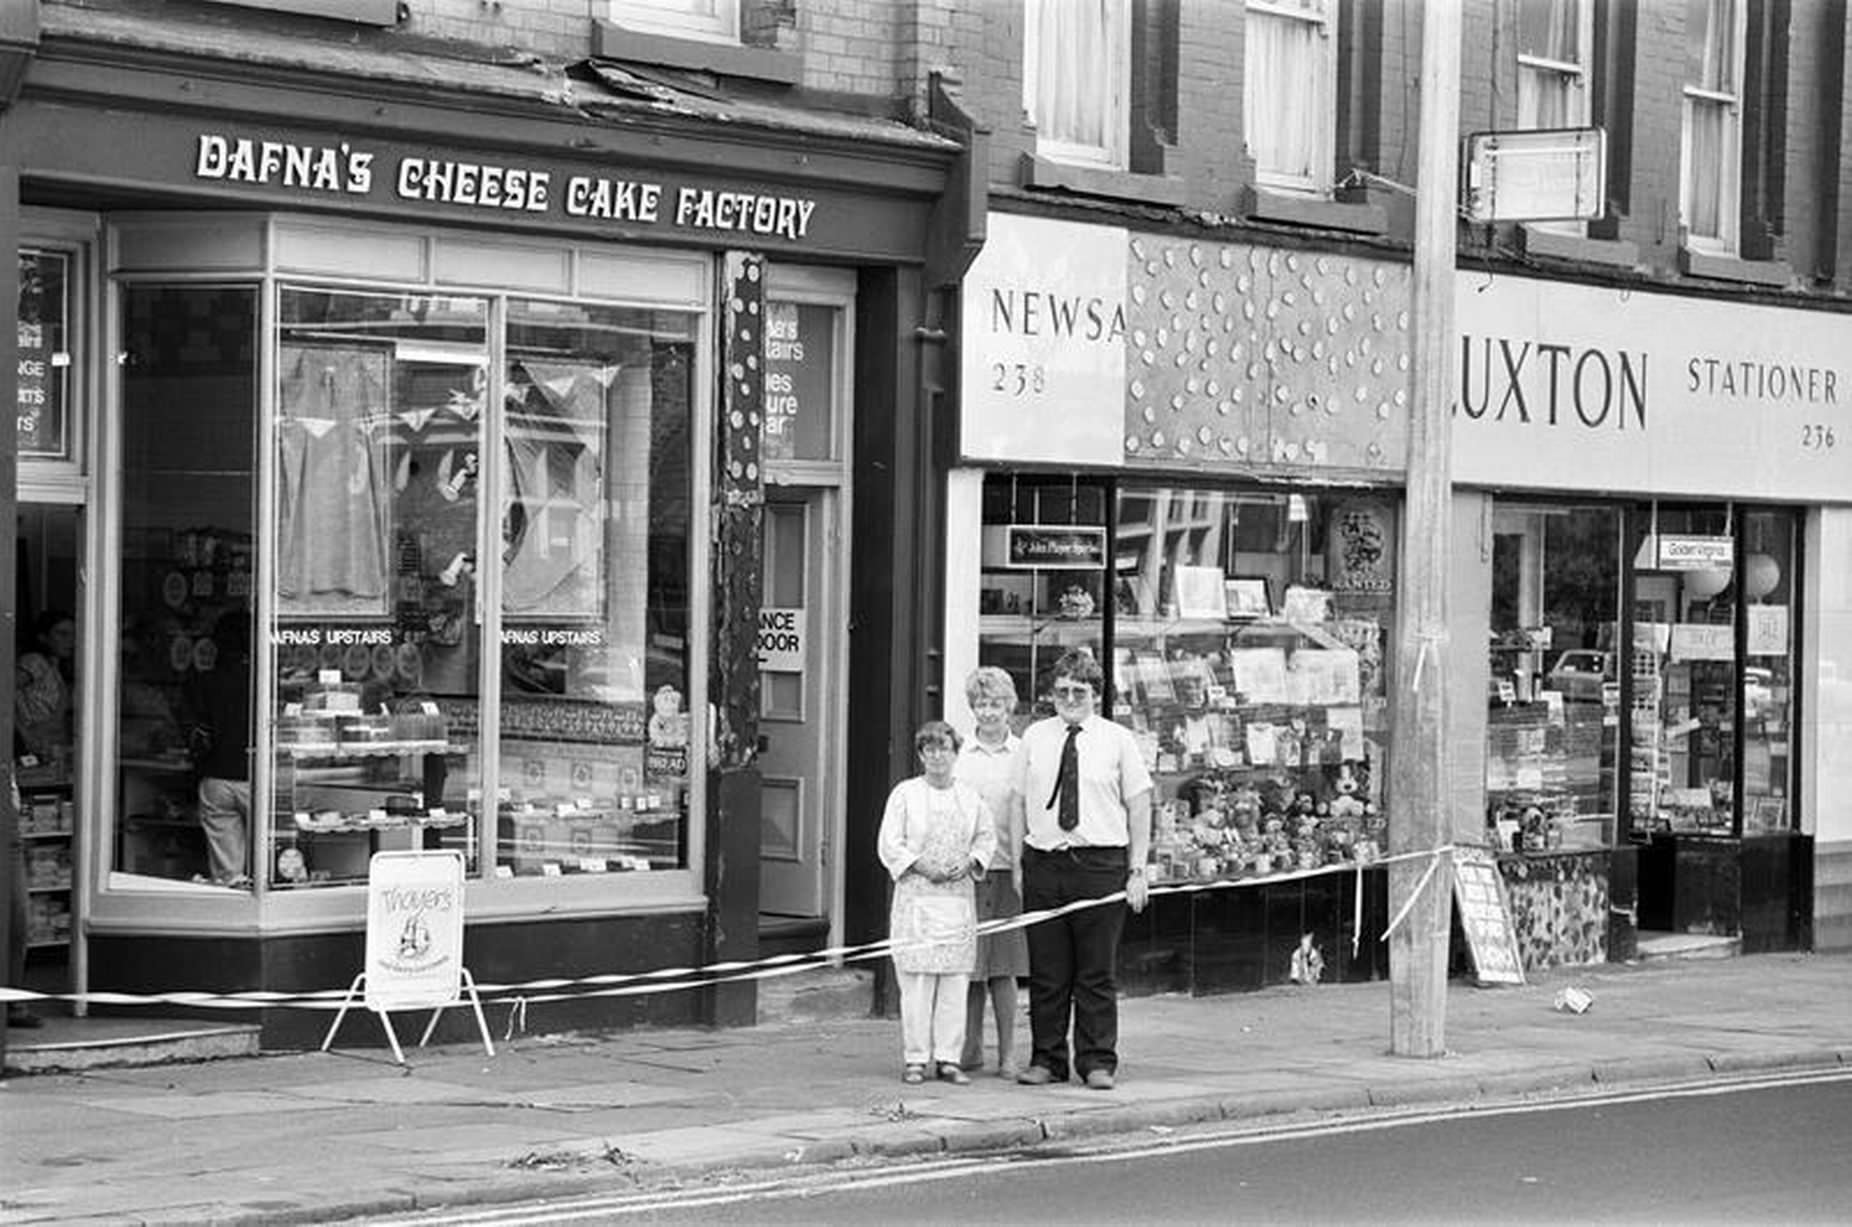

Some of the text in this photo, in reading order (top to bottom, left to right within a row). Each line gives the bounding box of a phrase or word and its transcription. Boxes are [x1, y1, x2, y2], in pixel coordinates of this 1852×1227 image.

[197, 134, 816, 239] DAFNA'S CHEESE CAKE FACTORY
[992, 362, 1045, 396] 238
[1452, 335, 1837, 431] UXTON STATIONER
[1801, 423, 1836, 449] 236
[326, 629, 392, 645] UPSTAIRS
[541, 629, 600, 645] UPSTAIRS
